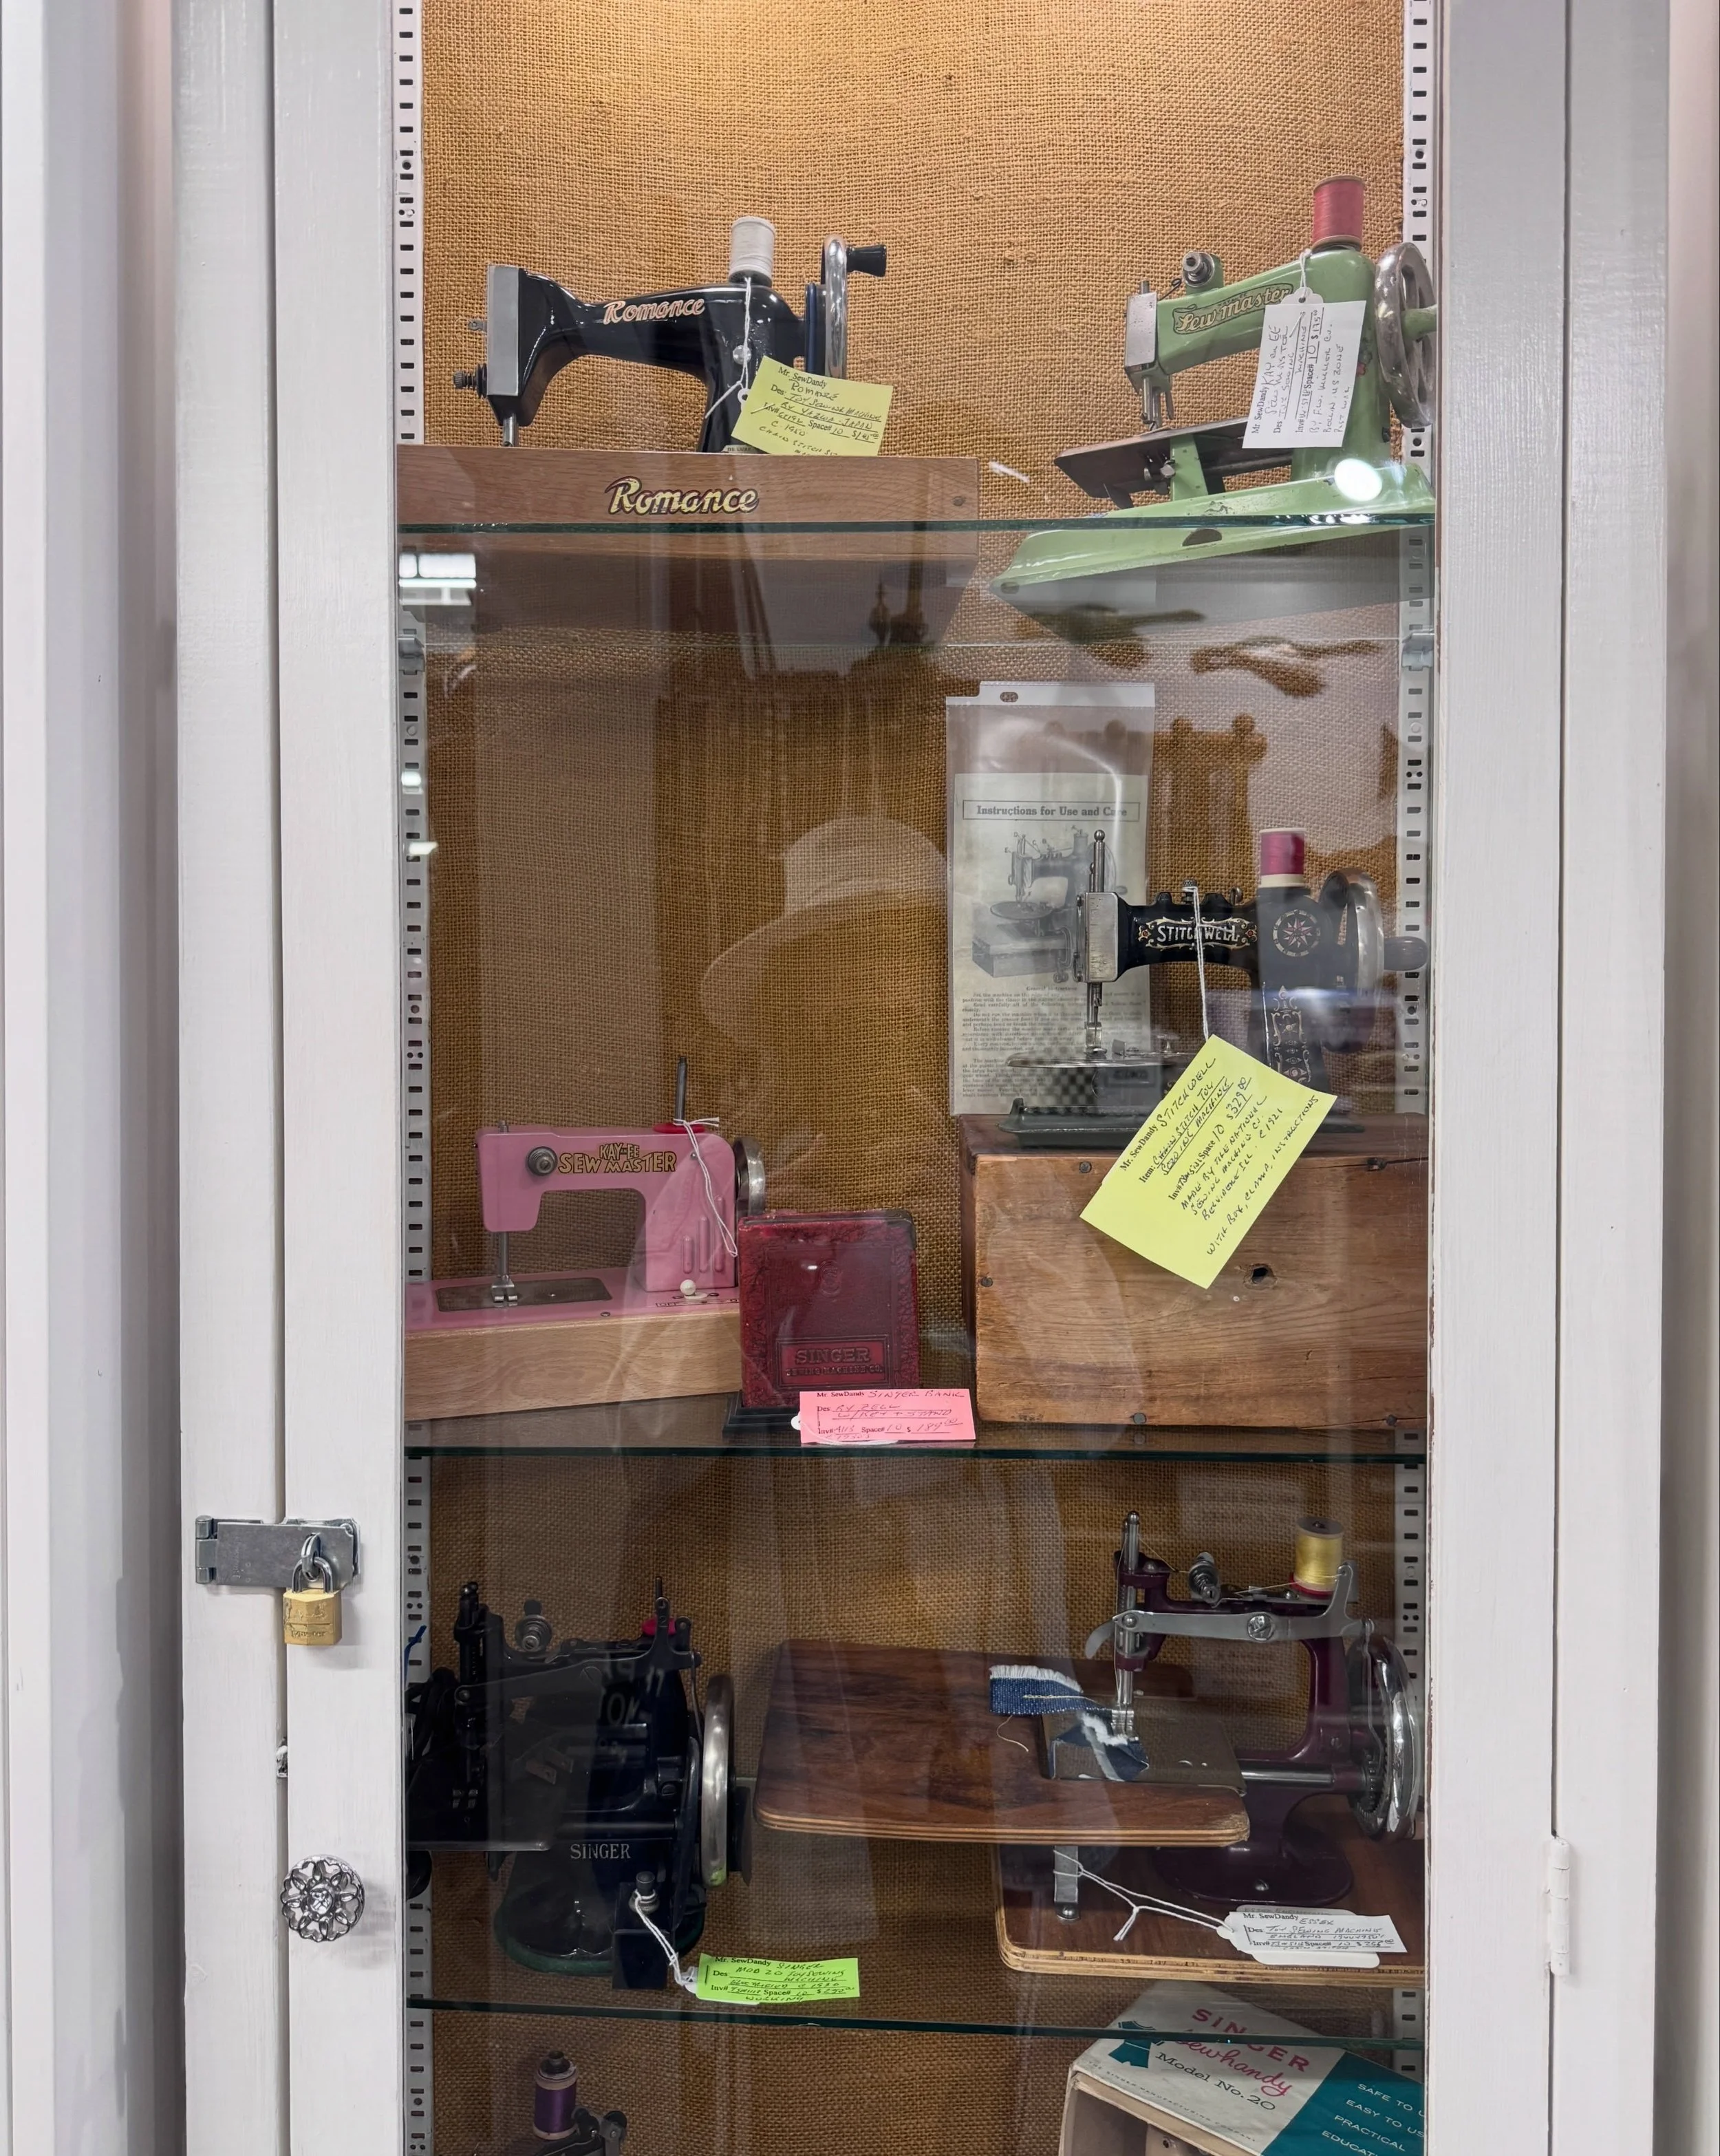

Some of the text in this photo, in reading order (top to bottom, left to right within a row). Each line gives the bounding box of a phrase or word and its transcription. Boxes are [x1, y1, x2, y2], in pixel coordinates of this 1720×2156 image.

[603, 299, 705, 325] Romance
[777, 366, 827, 389] Mr. SewDandy
[1254, 386, 1269, 420] SewDandy
[604, 476, 759, 515] Romance
[976, 805, 1038, 817] Instructions
[1040, 806, 1057, 816] for
[1060, 806, 1078, 816] Use
[1081, 807, 1099, 816] and
[1119, 1159, 1133, 1171] Mr.
[1129, 1124, 1157, 1157] SewDandy
[1198, 1140, 1215, 1159] Space
[558, 1151, 677, 1174] SEW MASTER
[1138, 1165, 1155, 1182] Item:
[795, 1347, 870, 1365] SINGER
[785, 1368, 821, 1376] SEWING
[822, 1364, 866, 1375] MACHINE
[861, 1426, 885, 1434] Space#
[570, 1843, 631, 1859] SINGER
[1259, 1912, 1299, 1922] SewDandy
[731, 1957, 771, 1967] SewDandy
[763, 1989, 792, 1997] Space#
[1155, 2052, 1276, 2111] Model No. 20
[1357, 2083, 1413, 2111] SAFE TO
[1346, 2100, 1425, 2138] EASY TO US
[1335, 2115, 1406, 2152] PRACTICAL
